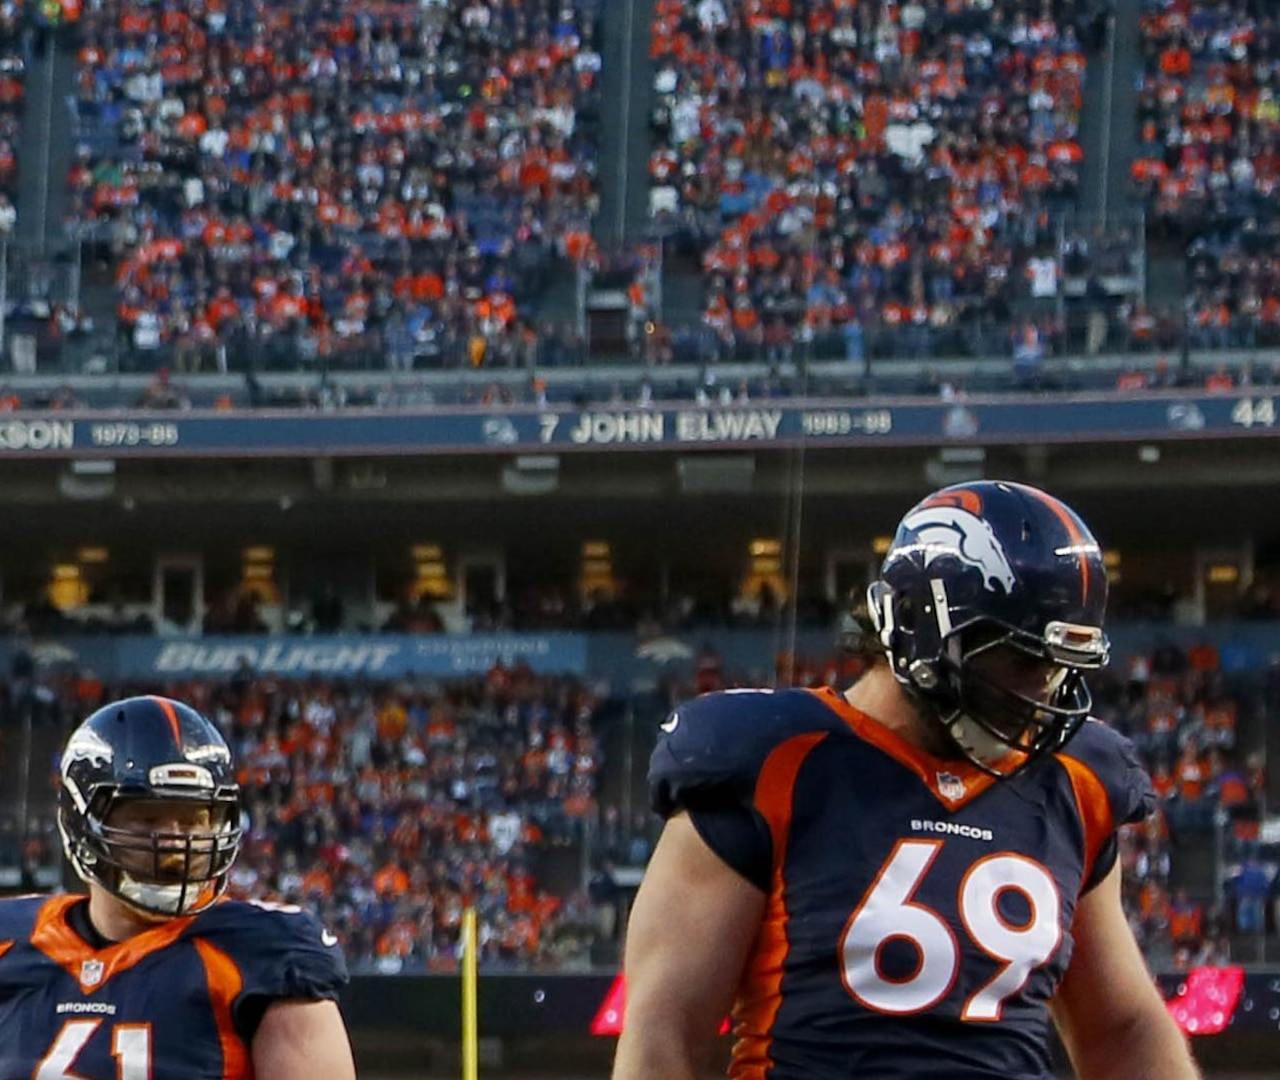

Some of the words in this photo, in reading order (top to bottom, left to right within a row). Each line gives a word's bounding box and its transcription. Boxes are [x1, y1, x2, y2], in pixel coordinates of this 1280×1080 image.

[540, 413, 560, 443] 7
[571, 412, 664, 443] JOHN
[676, 410, 782, 442] ELWAY
[1231, 399, 1277, 429] 44
[155, 642, 258, 671] BUD
[259, 642, 401, 671] LIGHT
[911, 819, 993, 841] BRONCOS
[840, 838, 1062, 1022] 69
[56, 1002, 116, 1015] BRONCOS
